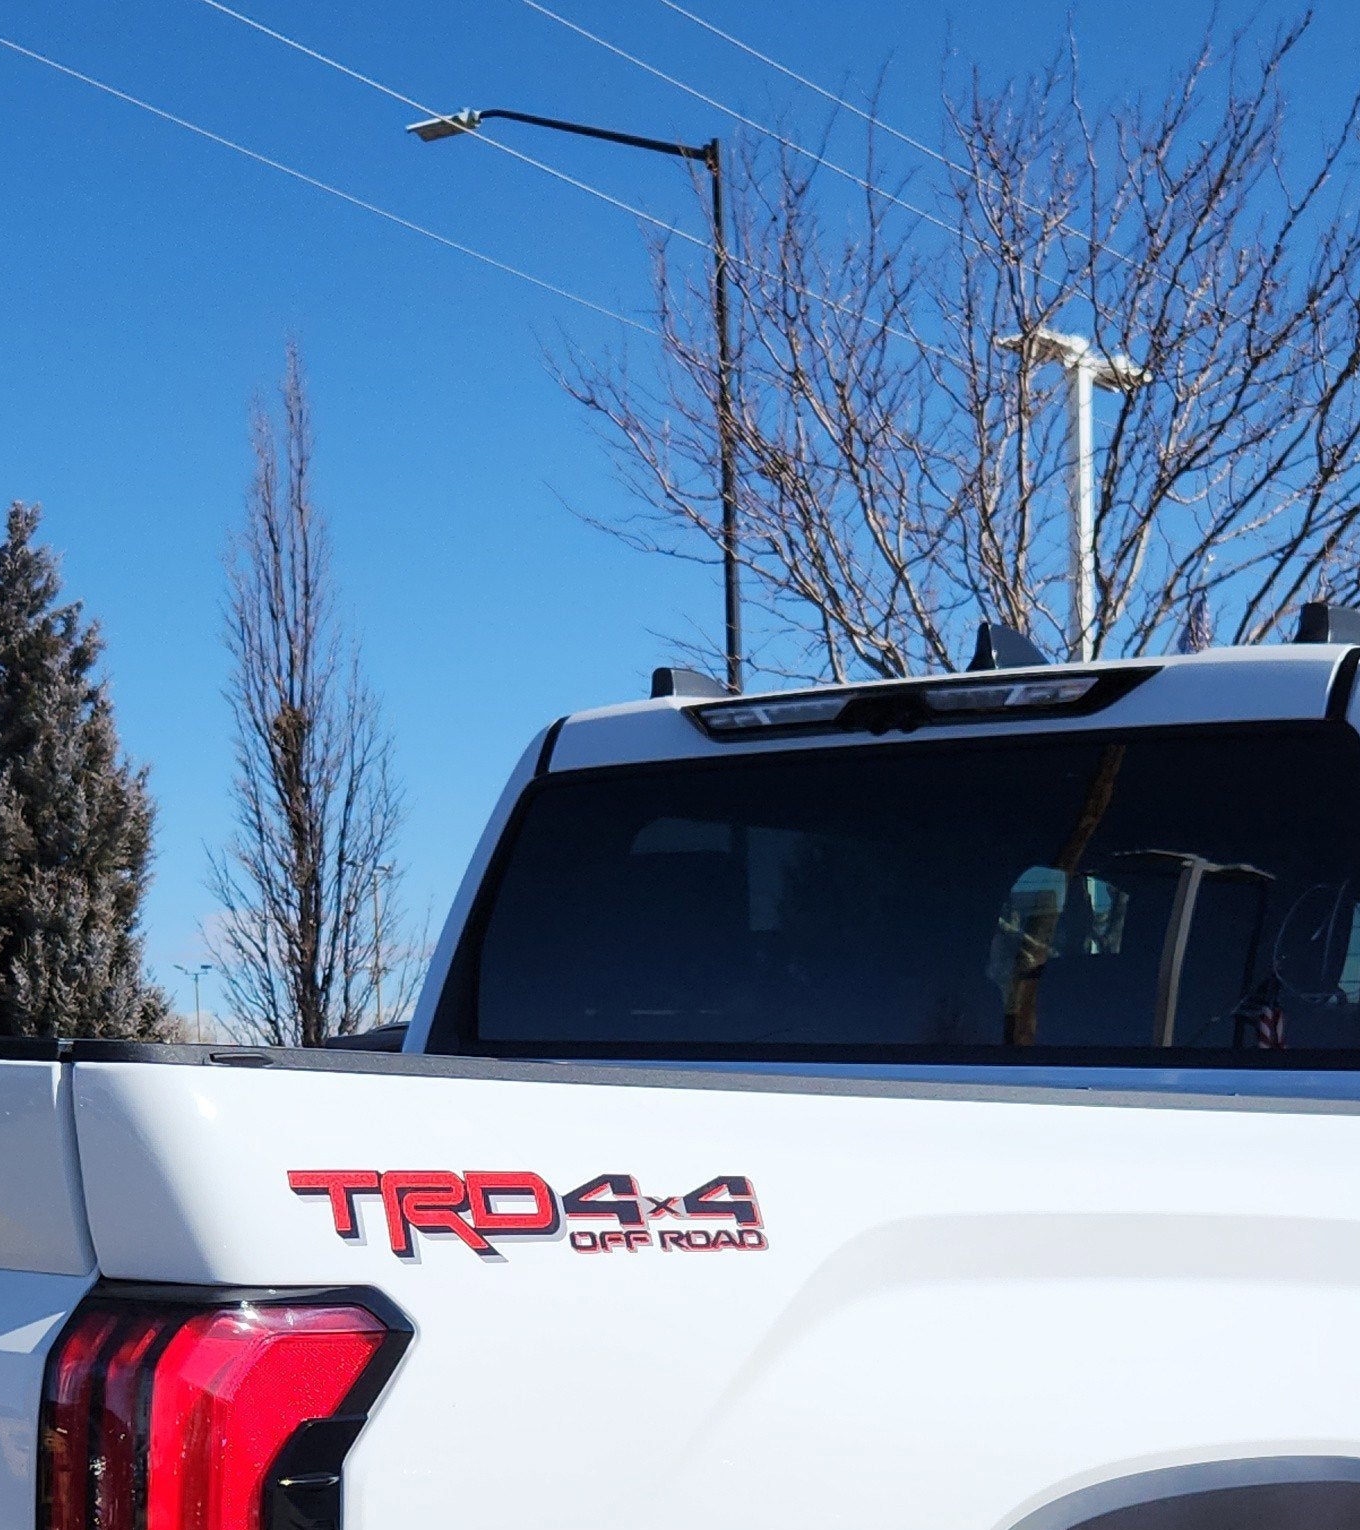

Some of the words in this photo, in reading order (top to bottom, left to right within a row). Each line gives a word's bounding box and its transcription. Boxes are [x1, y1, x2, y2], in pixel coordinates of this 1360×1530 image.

[287, 1169, 566, 1262] TRD
[562, 1173, 765, 1231] 4x4
[569, 1230, 651, 1253] OFF
[658, 1228, 768, 1252] ROAD
